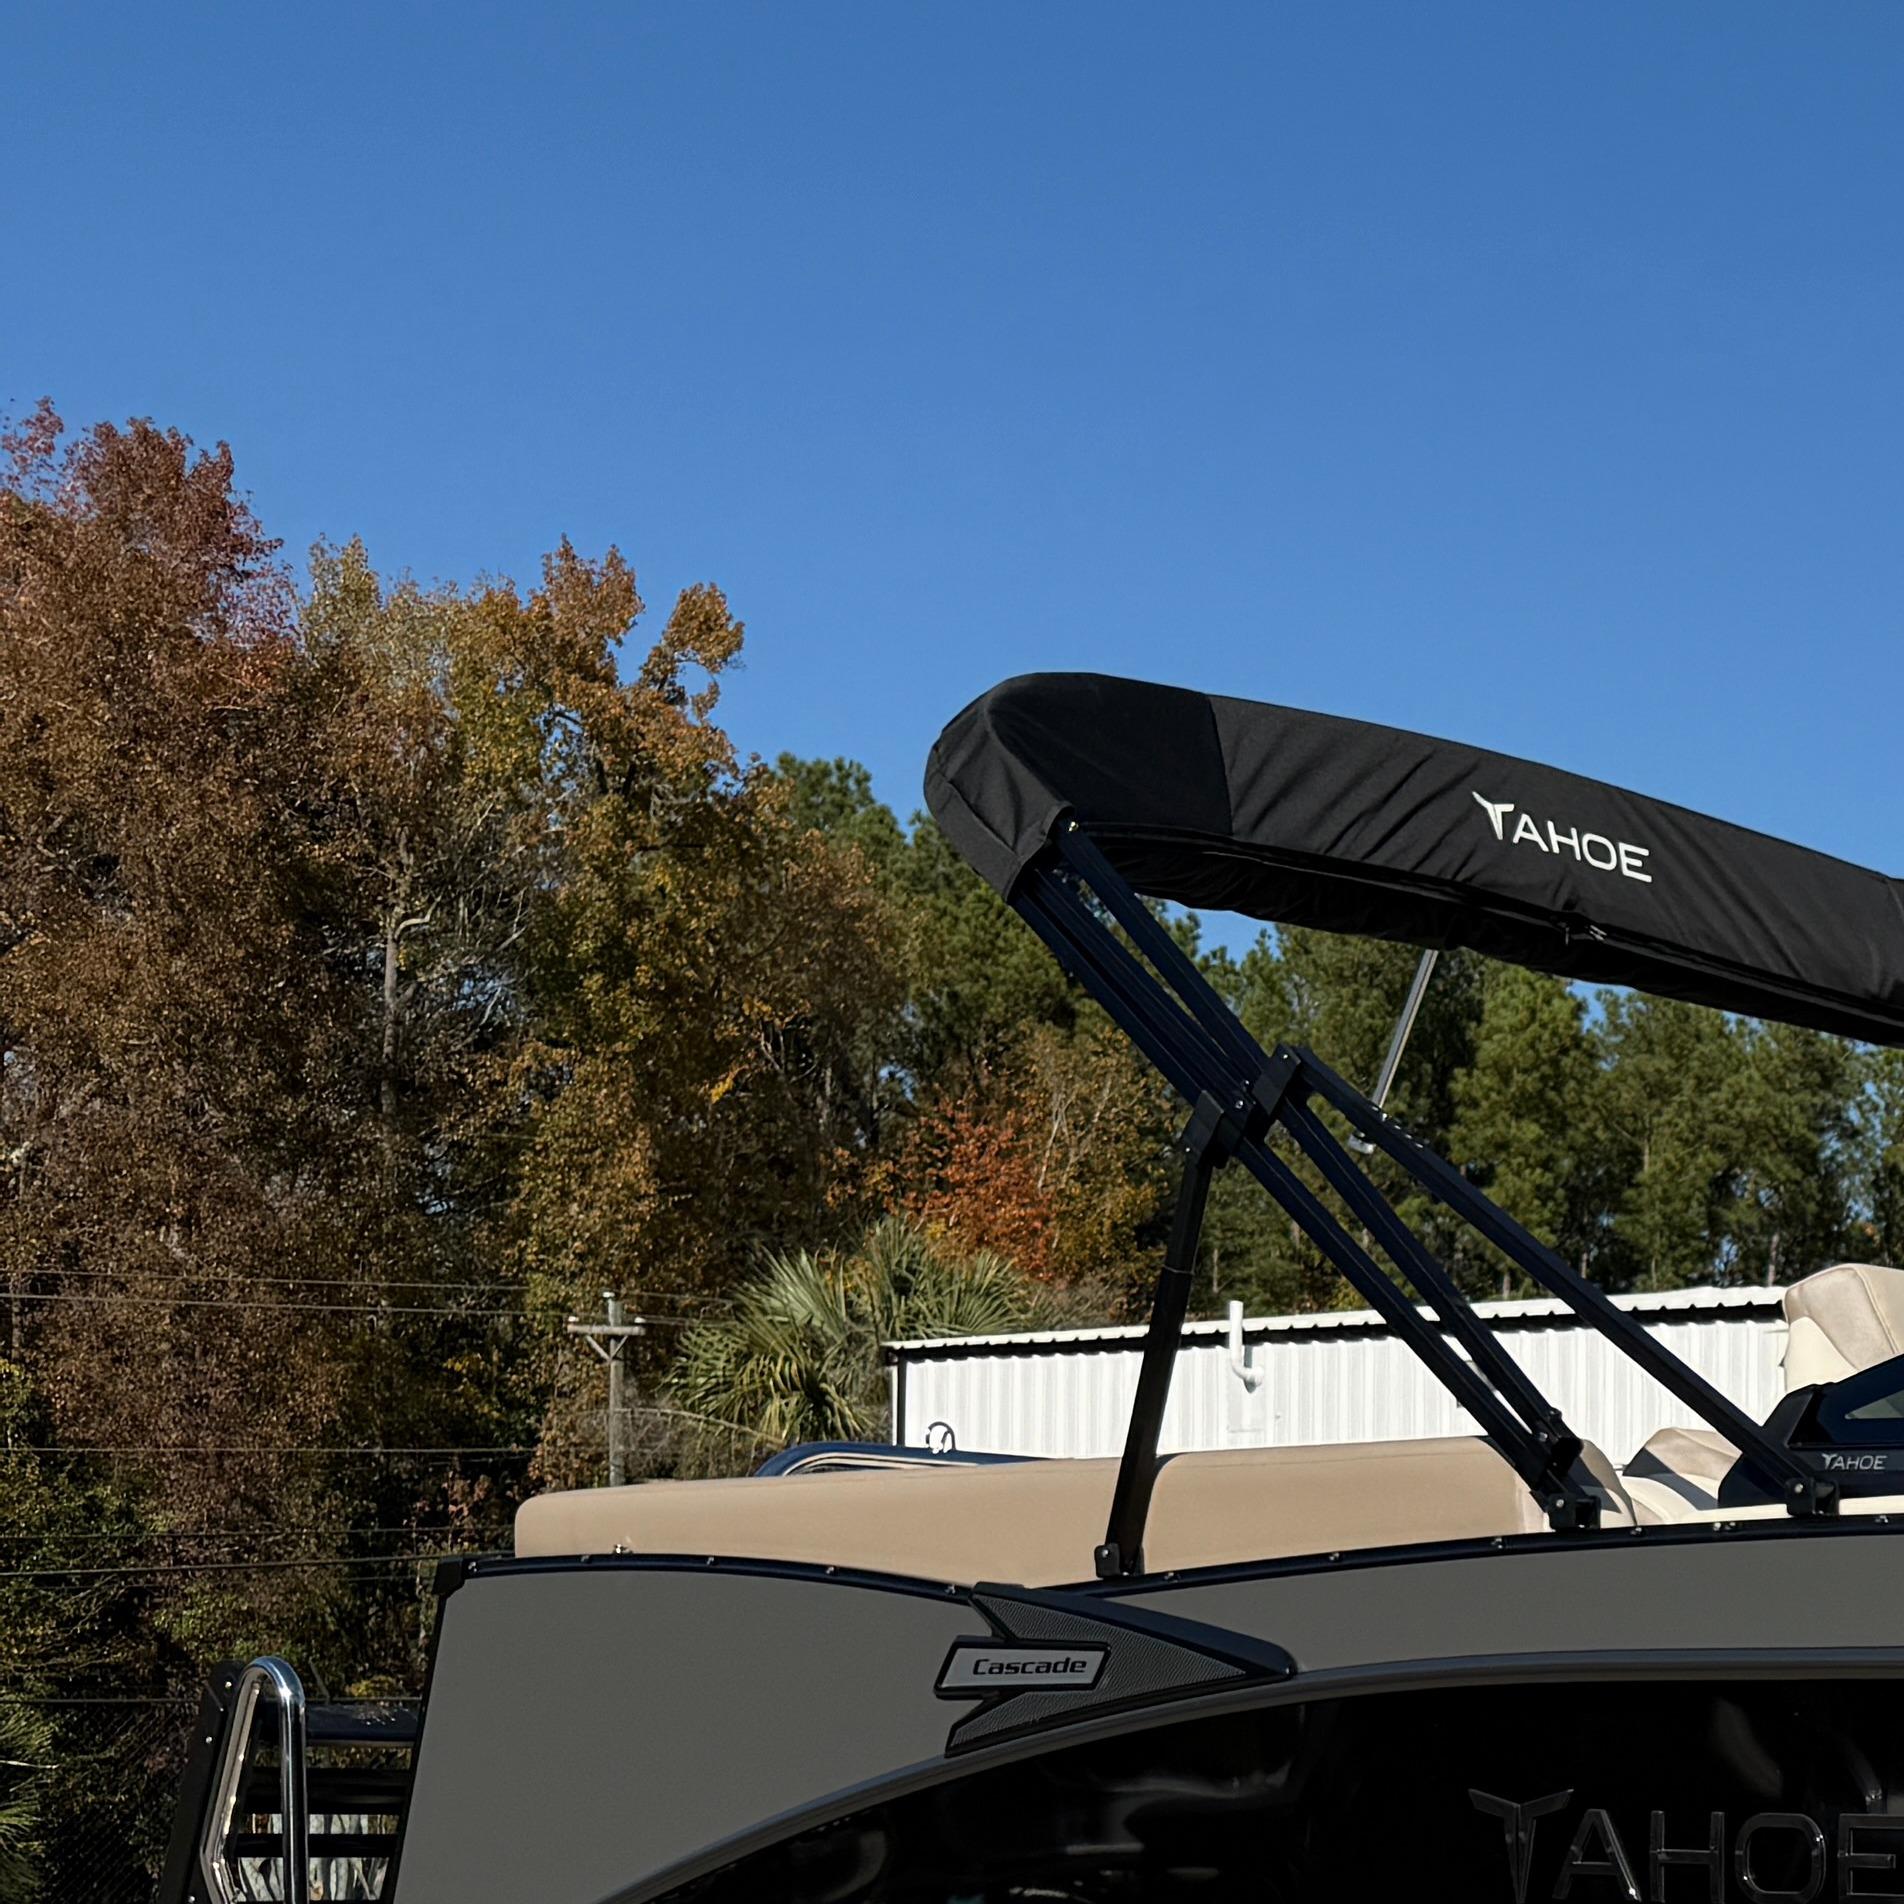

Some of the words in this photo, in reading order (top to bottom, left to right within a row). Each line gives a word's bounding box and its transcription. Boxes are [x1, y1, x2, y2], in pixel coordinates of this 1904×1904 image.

[1472, 791, 1652, 882] TAHOE
[1822, 1453, 1887, 1470] TAHOE
[973, 1657, 1087, 1675] Cascade
